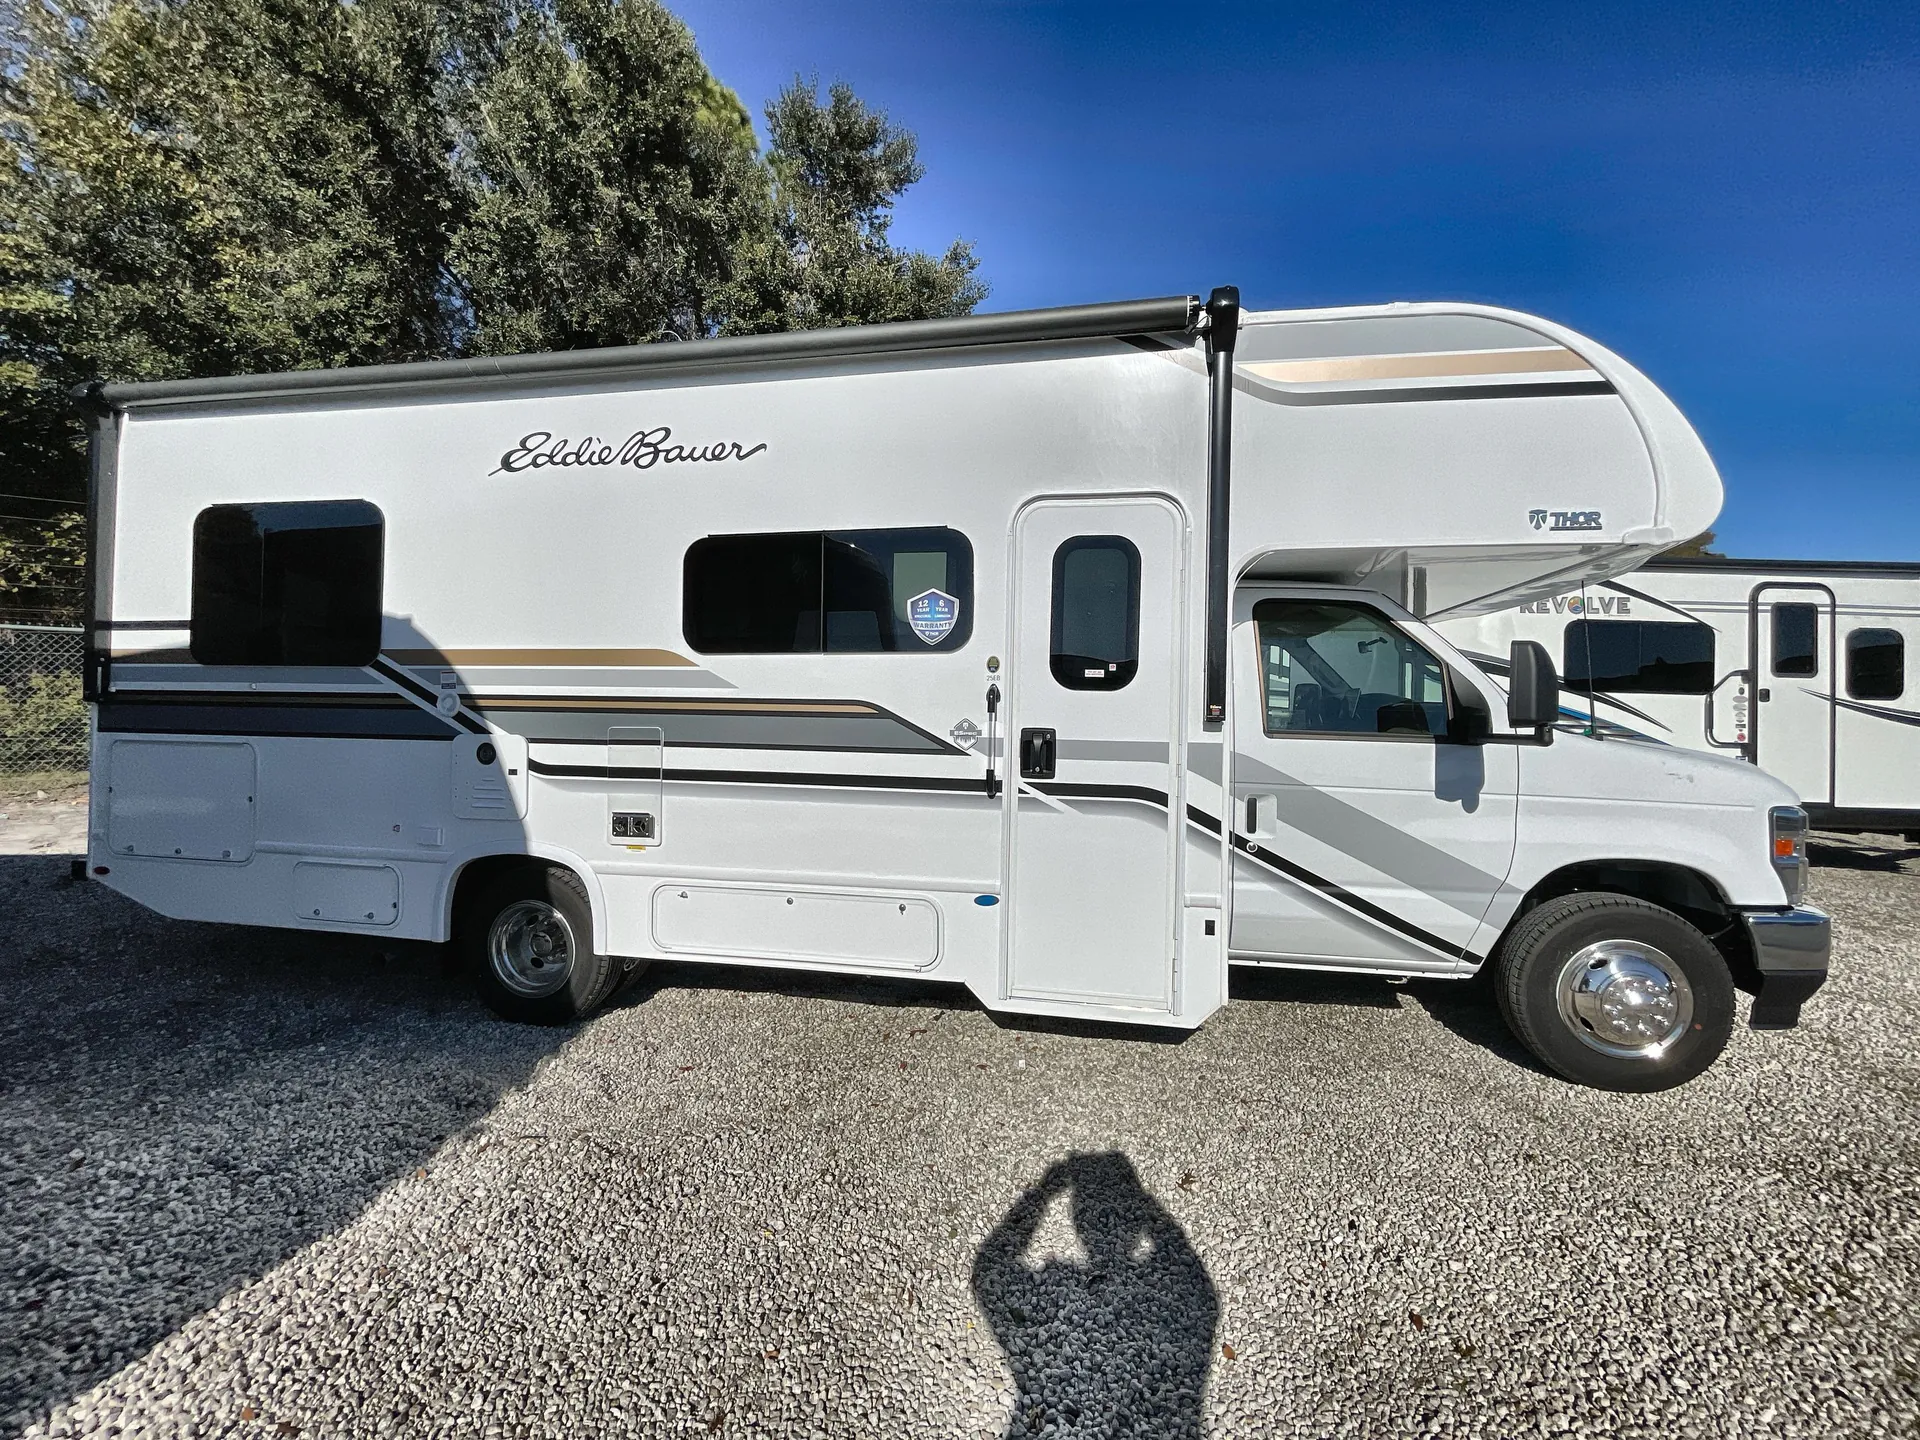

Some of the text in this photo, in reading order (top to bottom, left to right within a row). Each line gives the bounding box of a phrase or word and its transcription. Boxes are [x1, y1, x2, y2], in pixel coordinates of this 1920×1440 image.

[488, 426, 768, 476] Eddie Bauer
[1549, 511, 1602, 528] THOR
[917, 599, 929, 608] 12
[938, 599, 945, 607] 6
[1519, 596, 1631, 615] REVOLVE
[913, 621, 953, 629] WARRANTY
